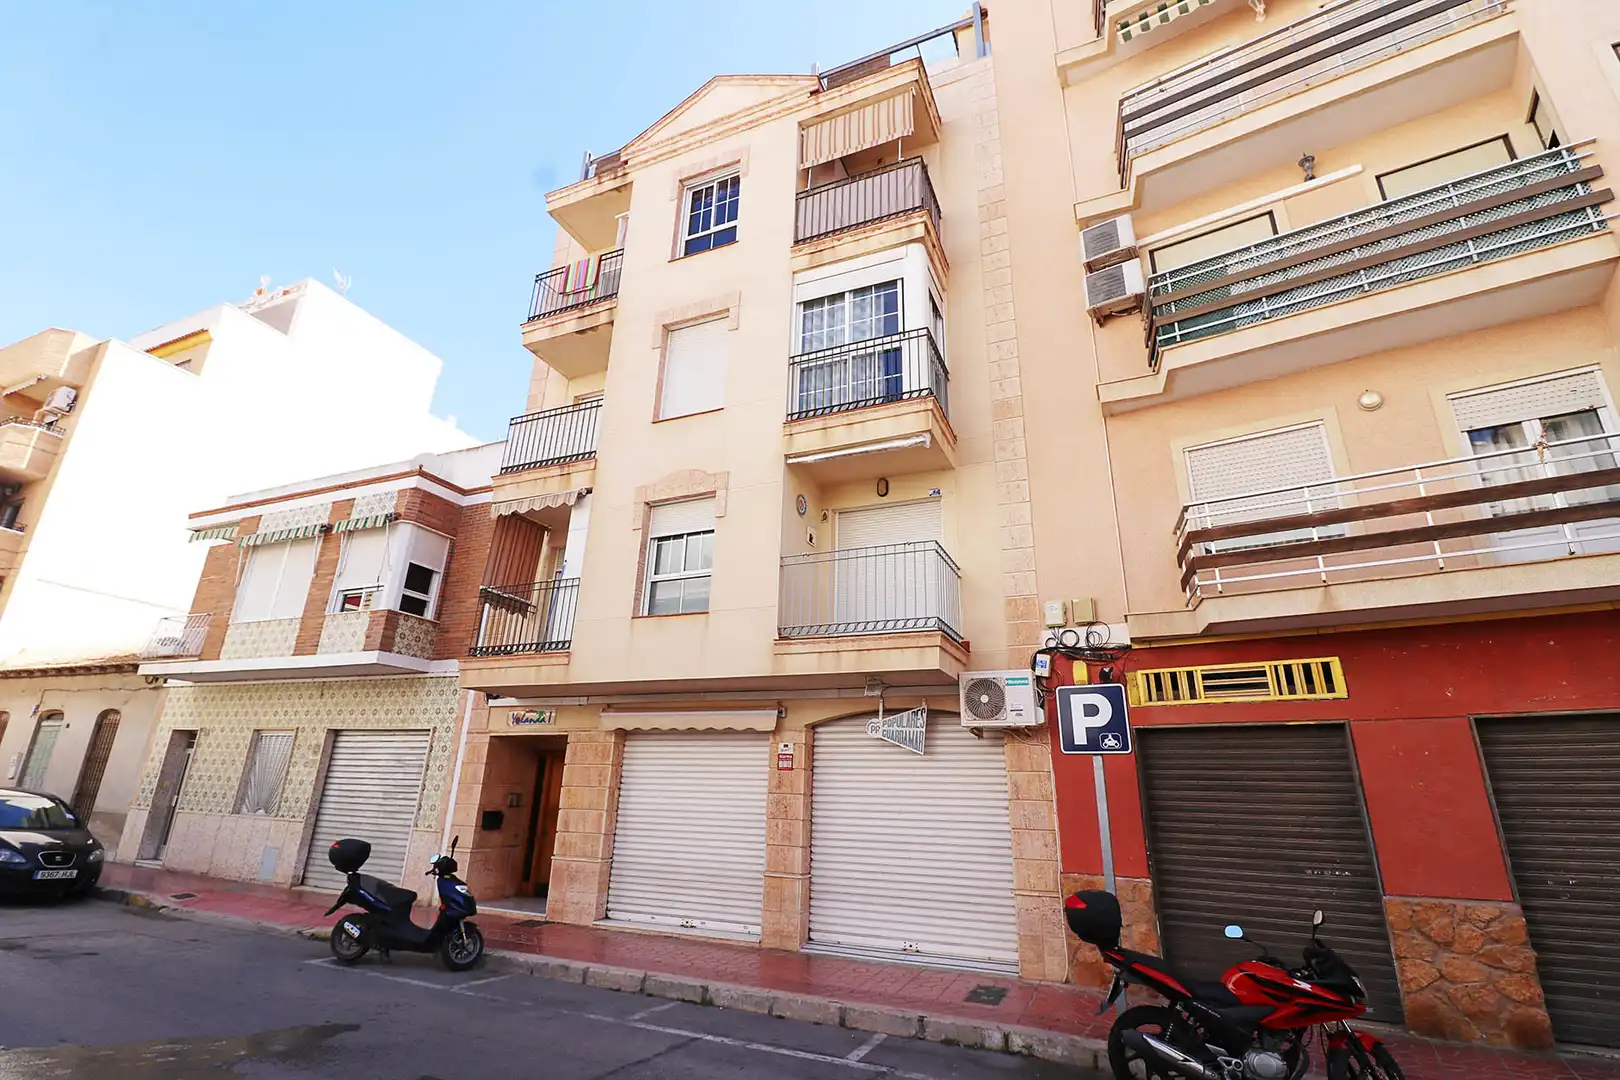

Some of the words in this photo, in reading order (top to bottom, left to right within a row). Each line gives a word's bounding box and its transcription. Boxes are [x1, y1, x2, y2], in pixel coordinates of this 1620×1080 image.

[511, 711, 546, 725] Yolanda
[882, 707, 927, 729] POPULARES
[1070, 693, 1112, 745] P
[870, 725, 881, 734] PP
[882, 729, 925, 753] GUARDAMAR
[40, 871, 59, 879] 9367
